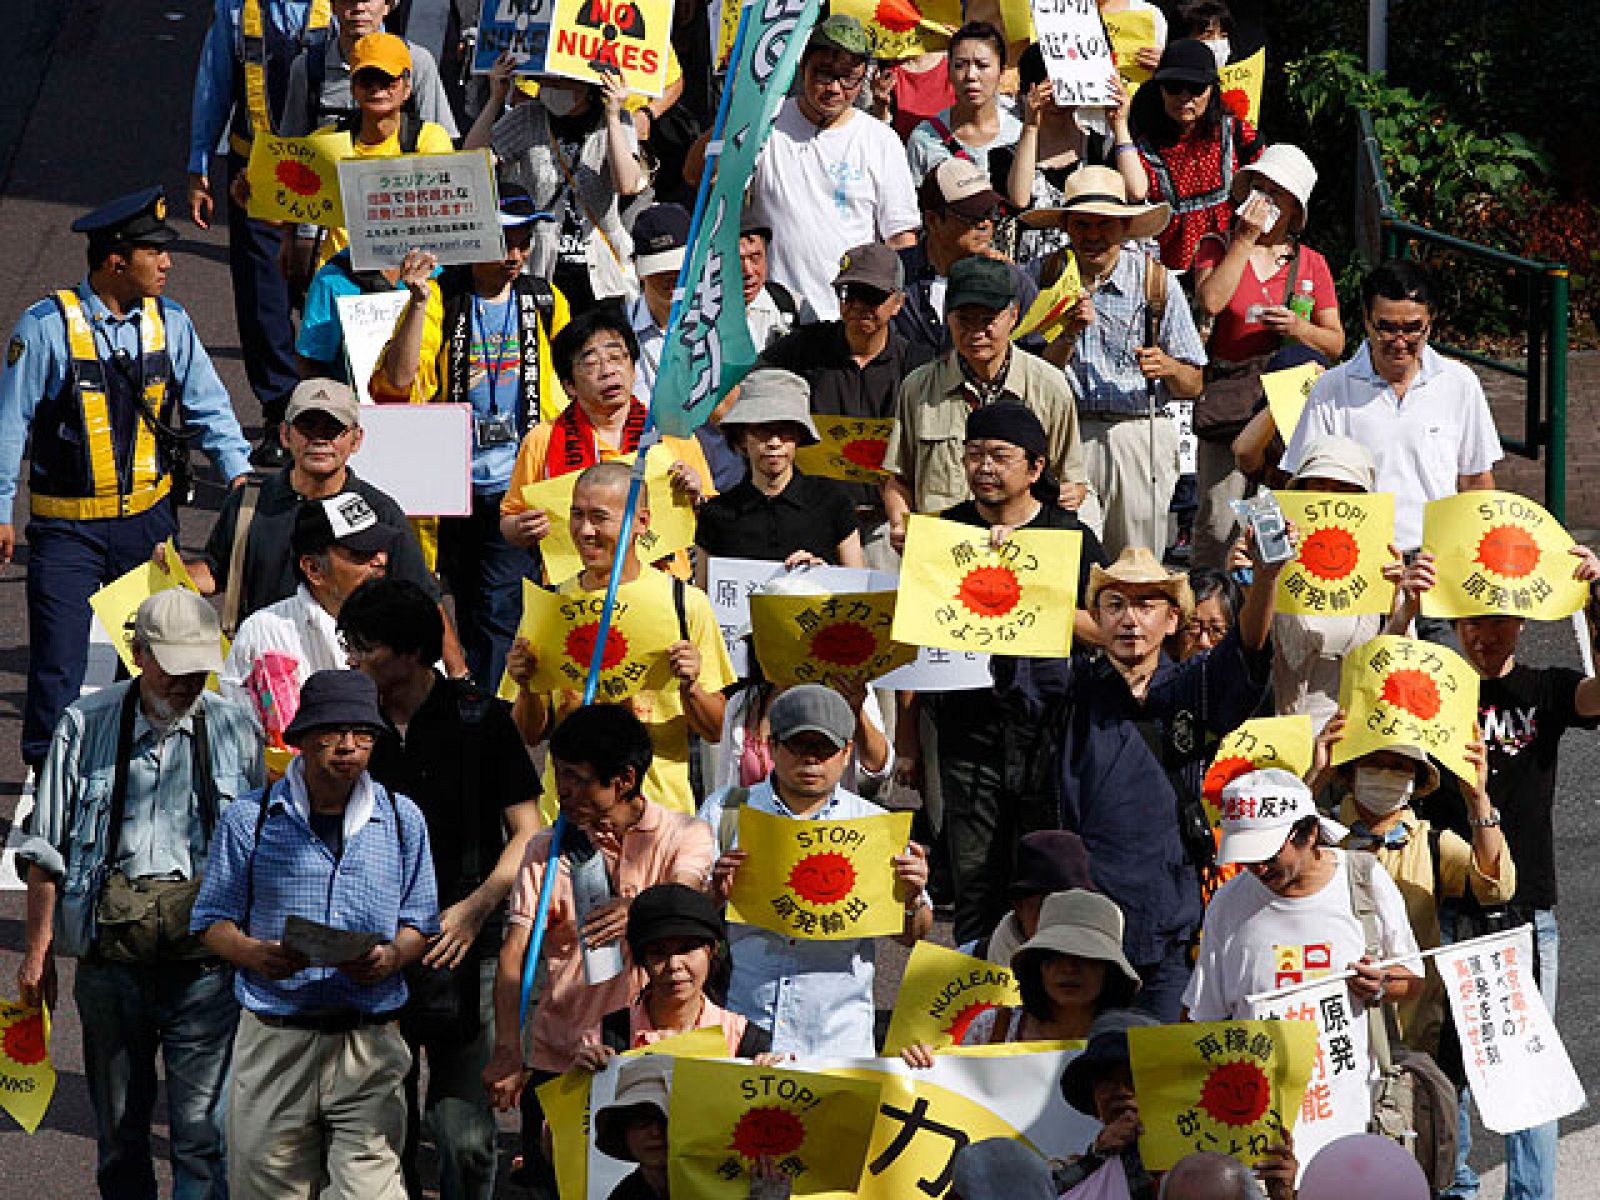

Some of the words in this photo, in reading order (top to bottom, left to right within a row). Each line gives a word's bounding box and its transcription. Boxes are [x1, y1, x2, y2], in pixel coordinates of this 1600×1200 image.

[590, 0, 636, 30] NO
[557, 29, 659, 74] NUKES
[378, 171, 451, 189] ラエリアンは
[275, 189, 334, 220] もんじゅ
[1303, 499, 1369, 528] STOP!
[1477, 498, 1545, 528] STOP!
[1284, 571, 1369, 612] 原発輸出
[1461, 571, 1554, 612] 原発輸出
[796, 826, 866, 852] STOP!
[770, 894, 869, 935] 原発輸出
[929, 969, 1011, 1019] NUCLEAR
[1489, 951, 1516, 1037] すべての
[1194, 1027, 1273, 1062] 再稼働
[1319, 994, 1356, 1076] 原発
[740, 1074, 822, 1111] STOP!
